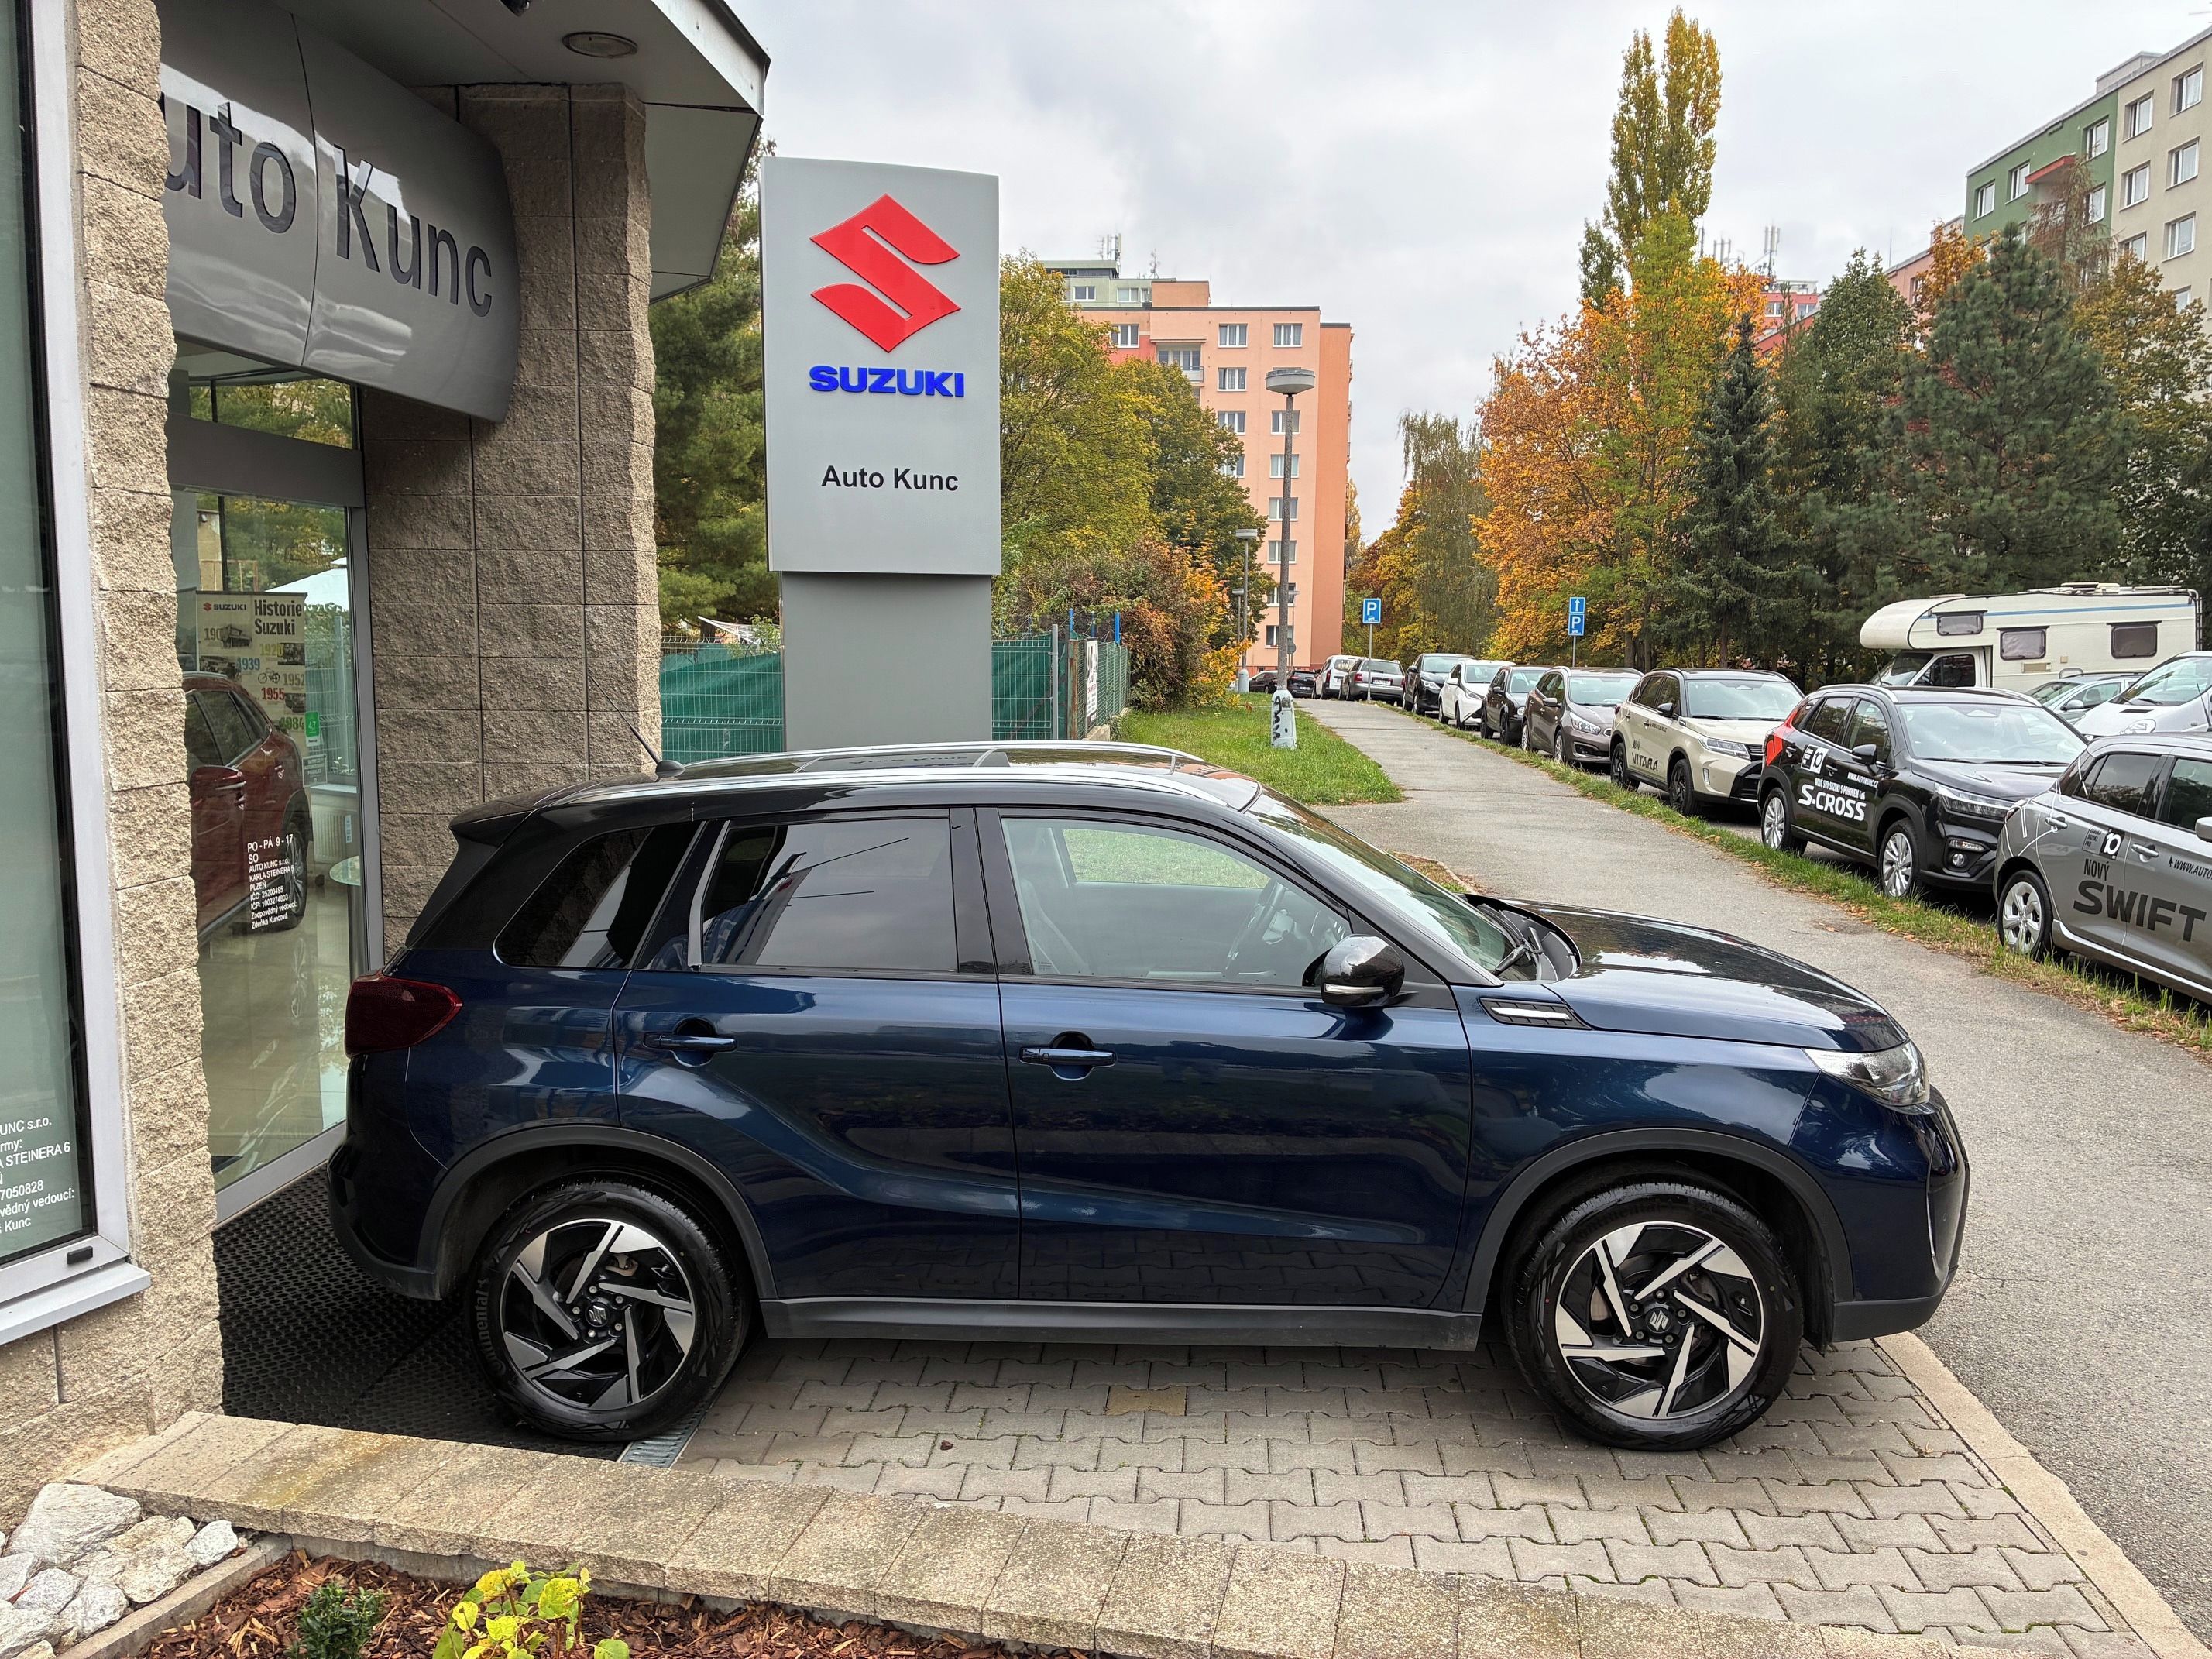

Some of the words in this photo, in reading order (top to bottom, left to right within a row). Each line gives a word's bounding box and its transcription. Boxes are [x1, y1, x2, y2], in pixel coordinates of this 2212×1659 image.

[334, 144, 492, 318] Kunc
[809, 366, 964, 397] SUZUKI
[821, 465, 884, 488] Auto
[894, 468, 959, 491] Kunc
[254, 599, 302, 617] Historie
[1367, 602, 1377, 615] P
[254, 619, 295, 635] Suzuki
[1572, 617, 1582, 629] P
[204, 627, 225, 641] 190
[236, 658, 260, 671] 1939
[283, 673, 305, 686] 1952
[261, 687, 285, 700] 1955
[1632, 752, 1659, 772] VITARA
[247, 841, 258, 853] PO
[263, 836, 273, 850] PÁ
[276, 836, 280, 847] 9
[285, 833, 294, 844] 17
[248, 853, 259, 864] SO
[249, 863, 263, 873] AUTO
[263, 859, 278, 870] KUNC
[249, 871, 266, 882] KARLA
[266, 865, 291, 878] STEINERA
[2083, 858, 2110, 881] NOVÝ
[2174, 859, 2212, 881] WWW.AUTO
[250, 879, 266, 891] PLZEŇ
[2073, 880, 2207, 943] SWIFT
[0, 1120, 24, 1136] UNC
[27, 1117, 51, 1130] s.r.o.
[5, 1143, 62, 1167] STEINERA
[64, 1141, 70, 1153] 6
[0, 1180, 44, 1200] 7050828
[33, 1187, 75, 1208] vedoucí:
[4, 1218, 32, 1232] Kunc
